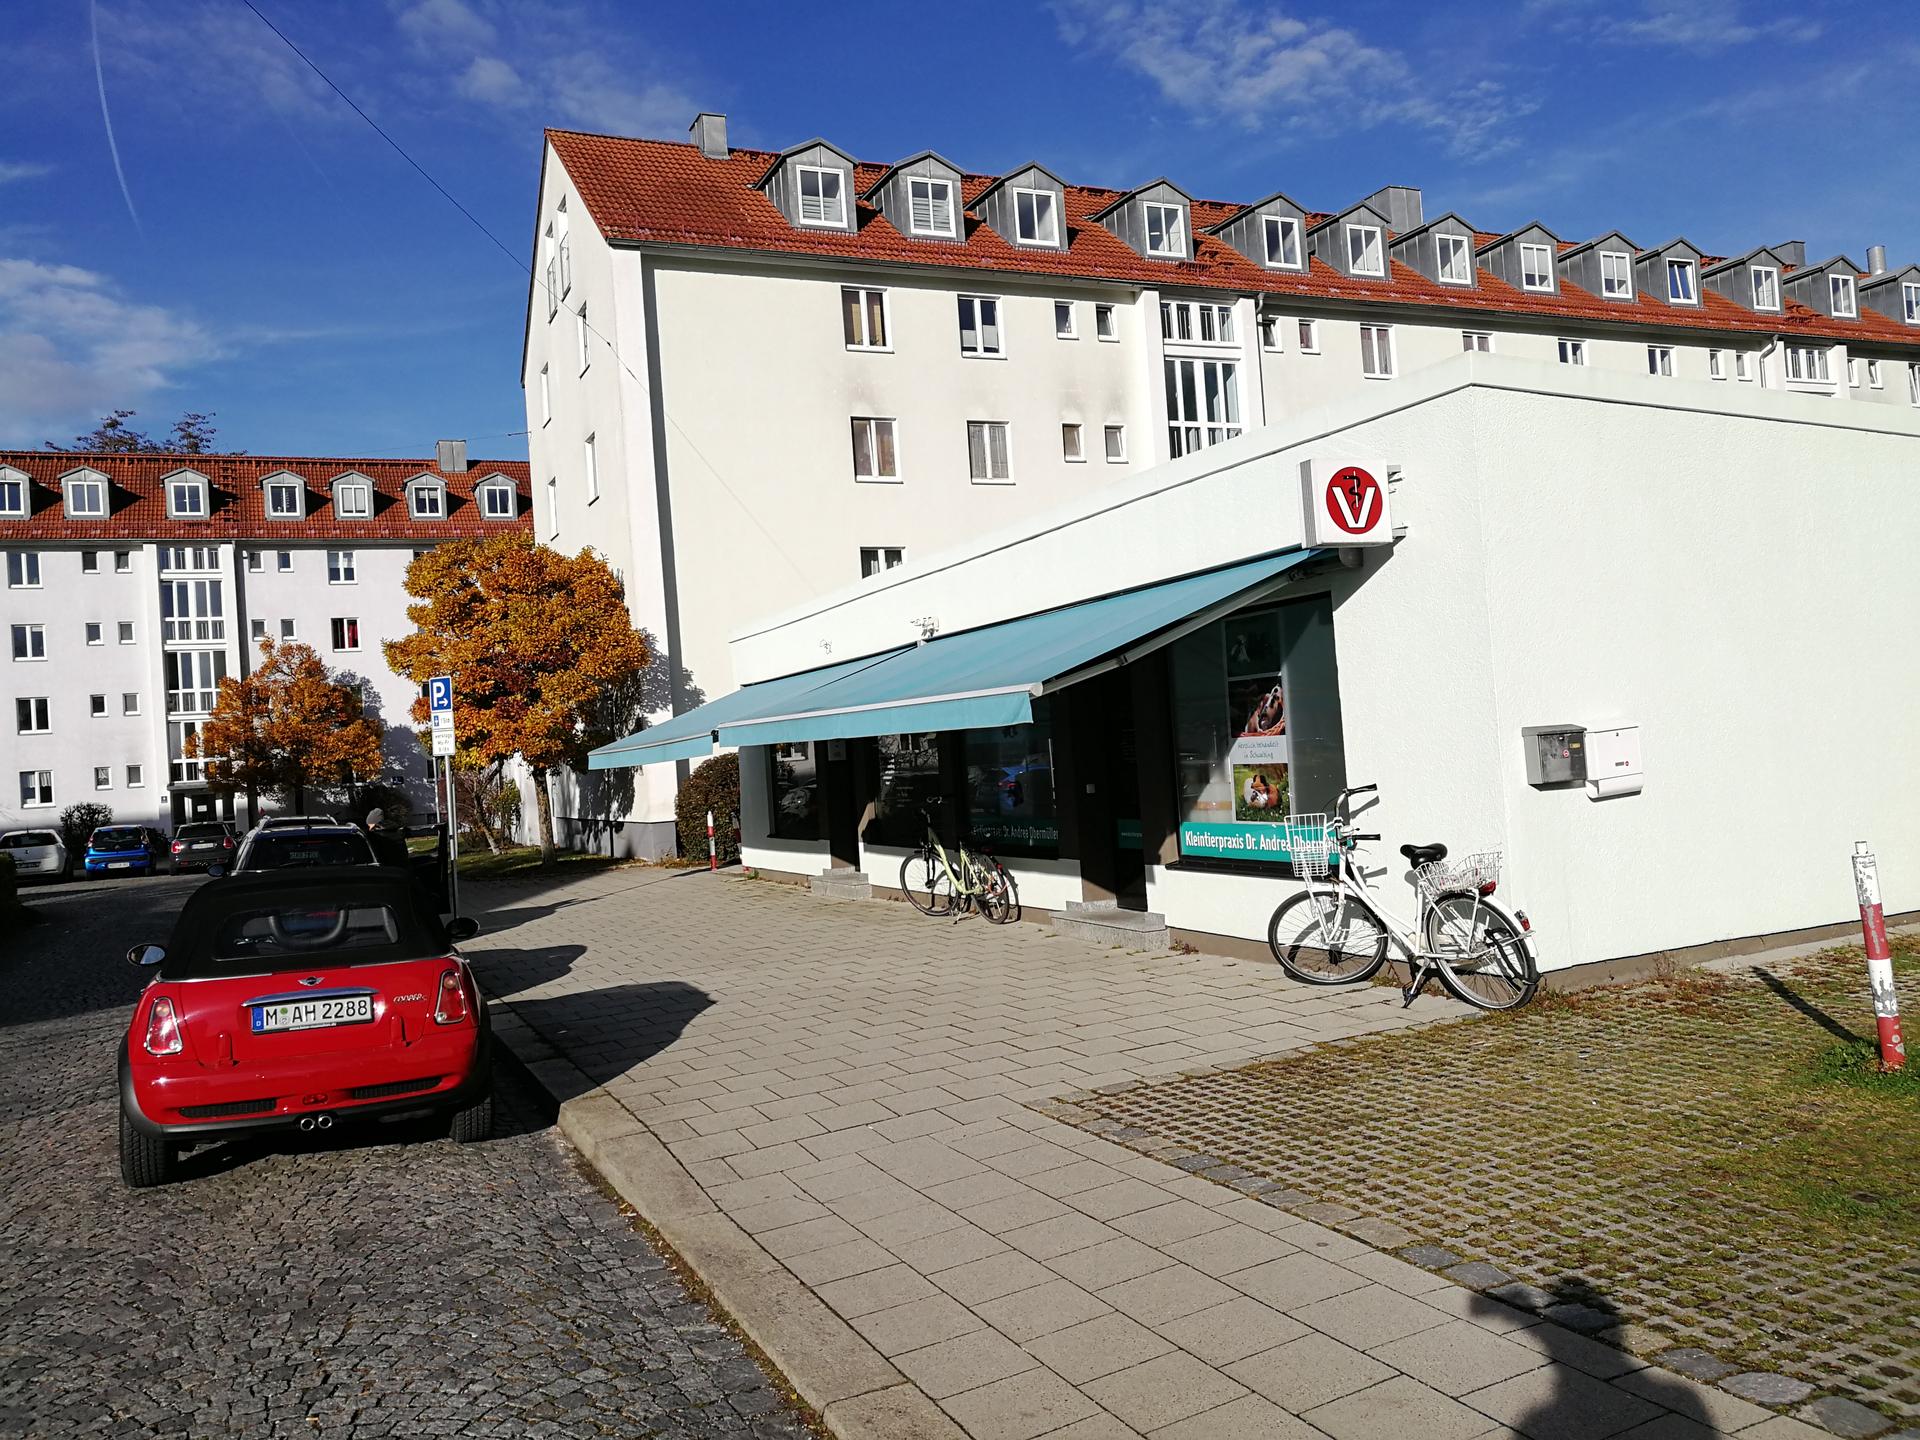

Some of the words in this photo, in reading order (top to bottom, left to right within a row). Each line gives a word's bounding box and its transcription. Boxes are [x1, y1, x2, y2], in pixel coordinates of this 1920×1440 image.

[1331, 486, 1376, 529] V
[432, 681, 446, 708] P
[1185, 830, 1244, 853] Kleintierpraxis
[1245, 832, 1258, 851] Dr.
[1259, 833, 1290, 852] Andrea
[265, 1008, 278, 1026] M
[292, 1004, 316, 1023] AH
[322, 1000, 368, 1020] 2288
